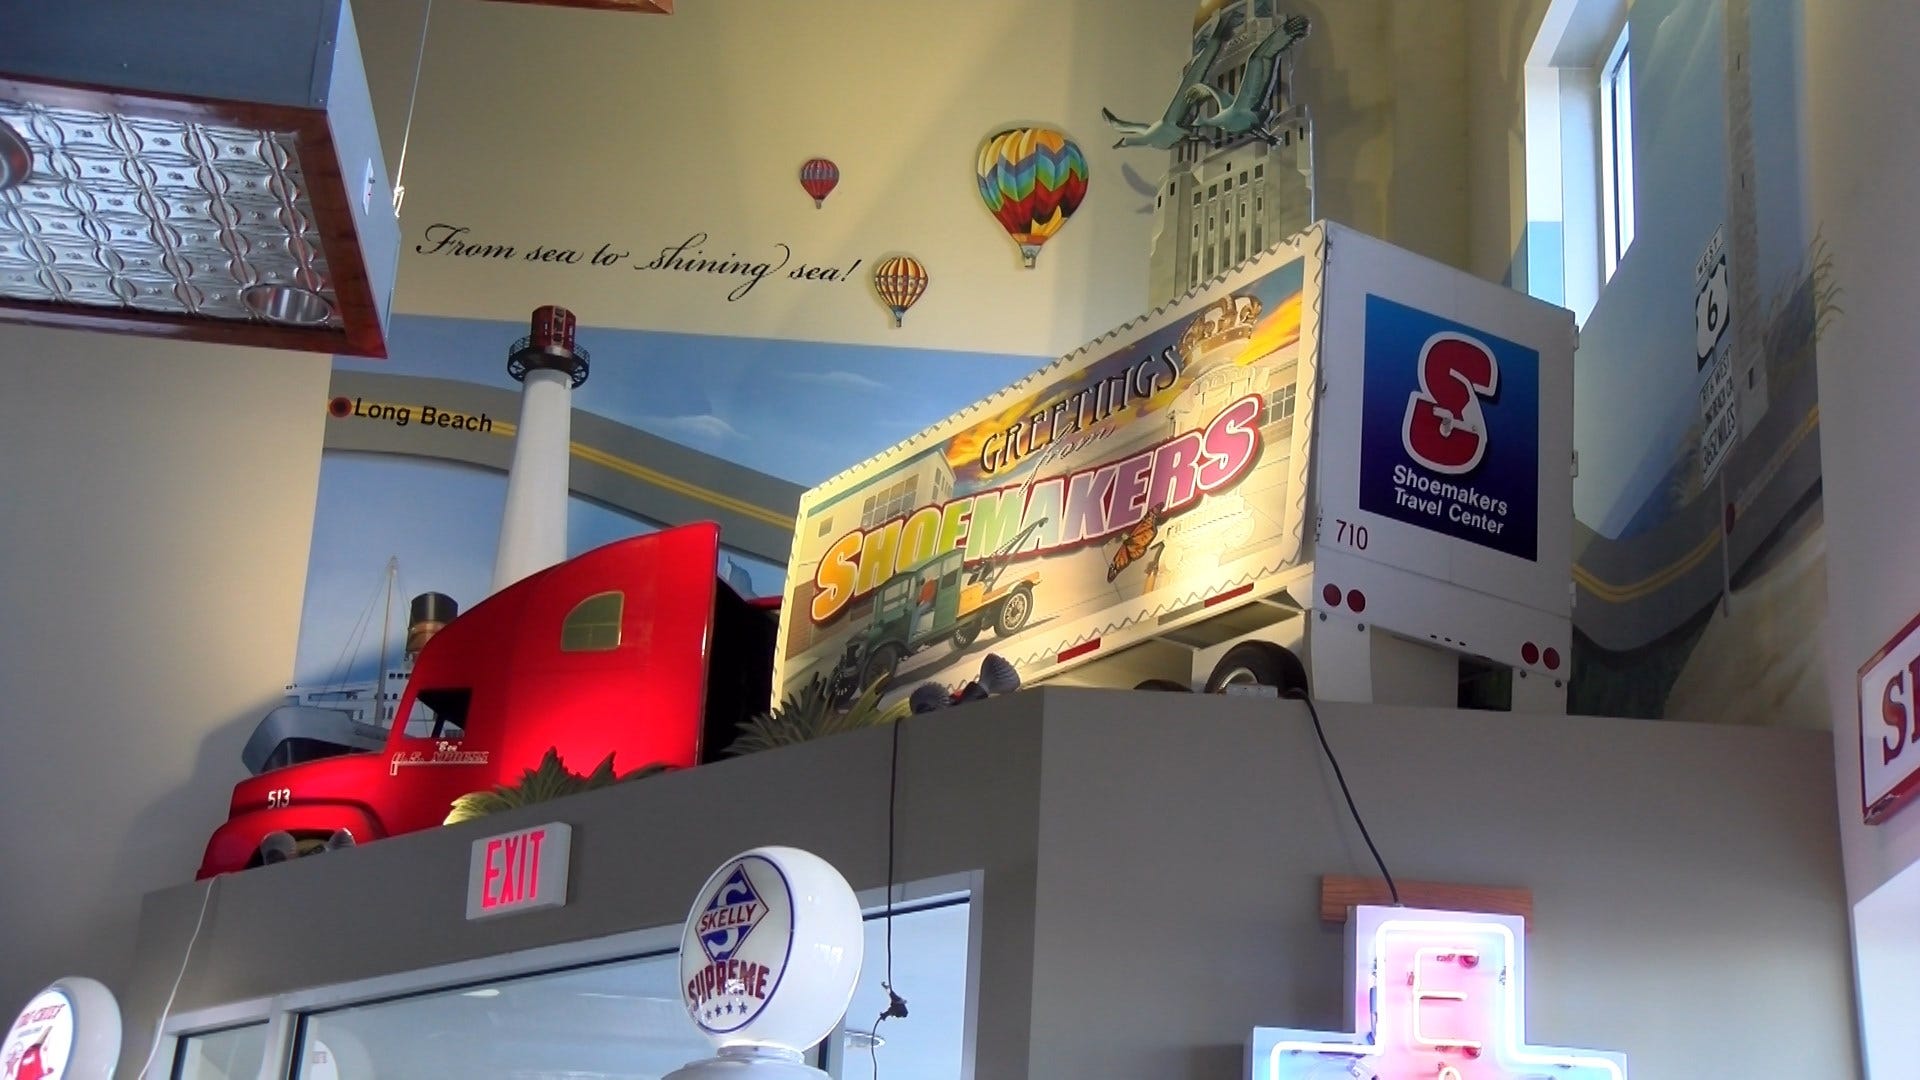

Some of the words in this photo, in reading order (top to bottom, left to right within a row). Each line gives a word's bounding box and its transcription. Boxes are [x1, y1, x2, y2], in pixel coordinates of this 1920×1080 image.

[416, 223, 517, 258] From
[523, 245, 586, 265] sea
[591, 243, 631, 267] to
[634, 232, 790, 301] shining
[788, 259, 862, 284] sea!
[1706, 290, 1718, 332] 6
[355, 397, 411, 426] Long
[420, 405, 493, 434] Beach
[980, 345, 1180, 475] GREETINGS
[1018, 421, 1117, 498] from
[809, 392, 1265, 627] SHOEMAKERS
[1393, 465, 1508, 517] Shoemakers
[1394, 487, 1442, 517] Travel
[1448, 502, 1505, 535] Center
[1335, 519, 1369, 550] 710
[267, 789, 291, 809] 513
[482, 831, 545, 910] EXIT
[700, 904, 758, 932] SKELLY
[688, 958, 770, 1013] SUPREME
